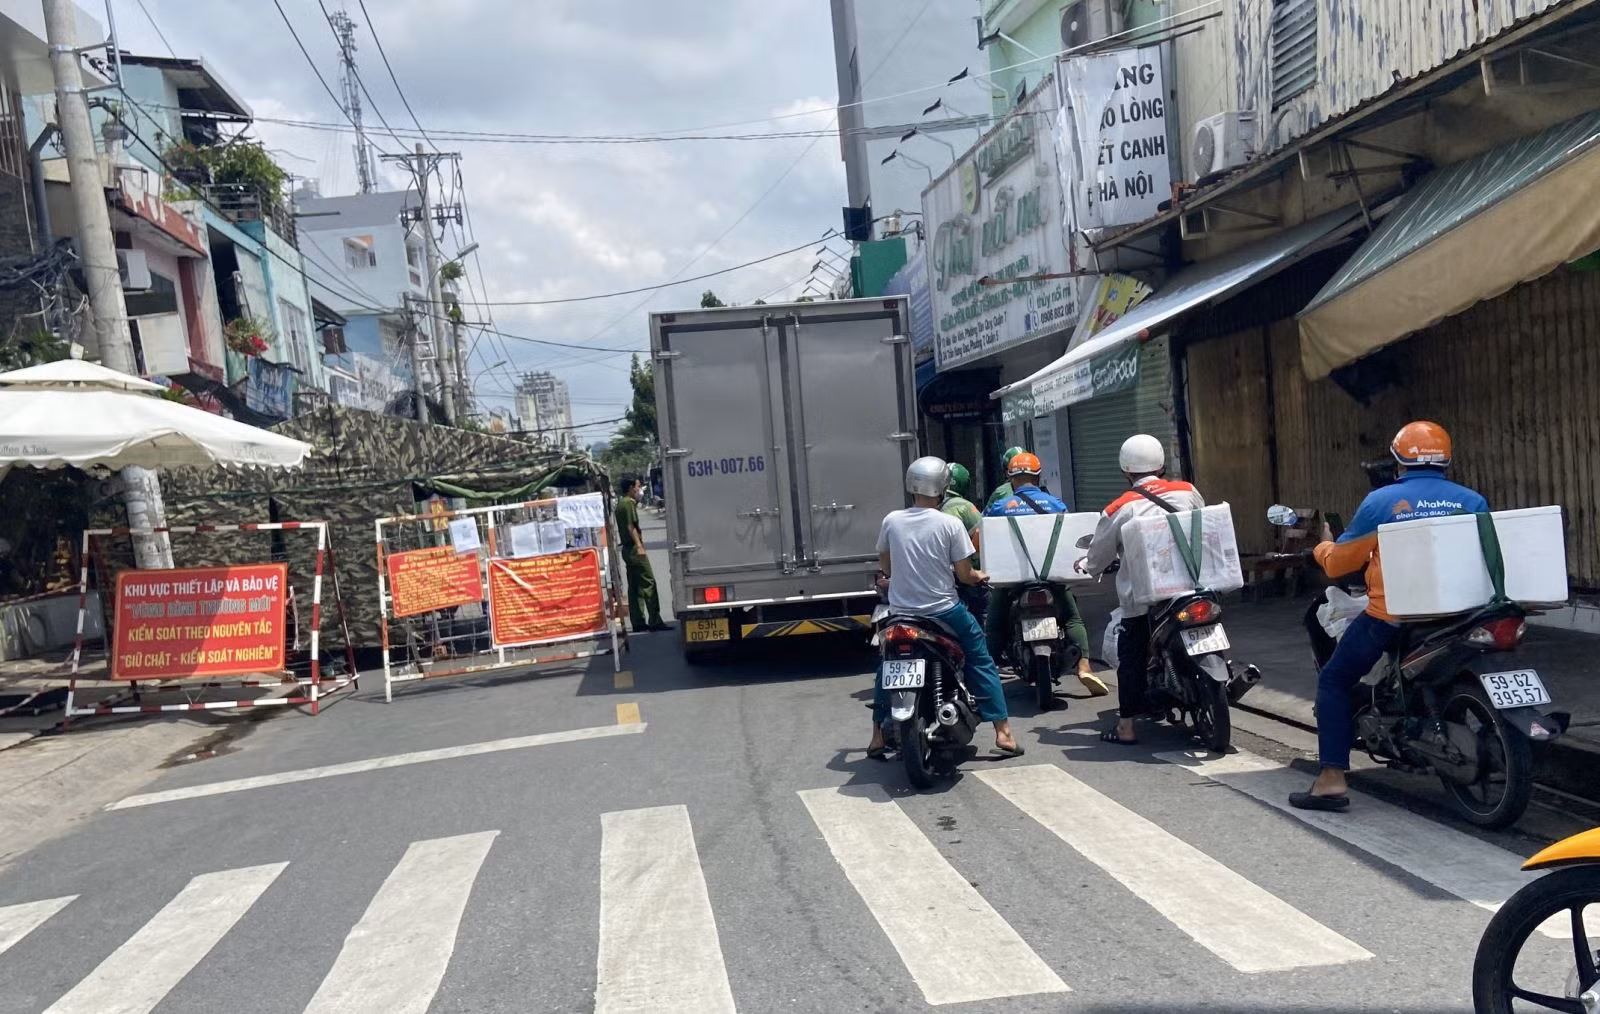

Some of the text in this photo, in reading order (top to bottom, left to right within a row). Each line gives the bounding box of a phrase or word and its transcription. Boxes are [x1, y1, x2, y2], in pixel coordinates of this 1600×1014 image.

[1120, 96, 1164, 124] LÒNG
[1121, 135, 1165, 161] CANH
[1125, 170, 1153, 199] NỘI
[1416, 499, 1462, 509] AhaMove
[125, 575, 278, 598] KHU VỰC THIẾT LẬP VÀ BẢO VỆ
[128, 617, 272, 641] KIỂM SOÁT THEO NGUYÊN TẮC
[698, 620, 716, 630] 63H
[144, 651, 171, 669] CHẶT
[180, 647, 205, 665] KIỂM
[208, 647, 233, 663] SOÁT
[889, 662, 917, 674] 59-Z1
[1490, 673, 1533, 690] 59-G2
[1493, 687, 1542, 705] 395.57
